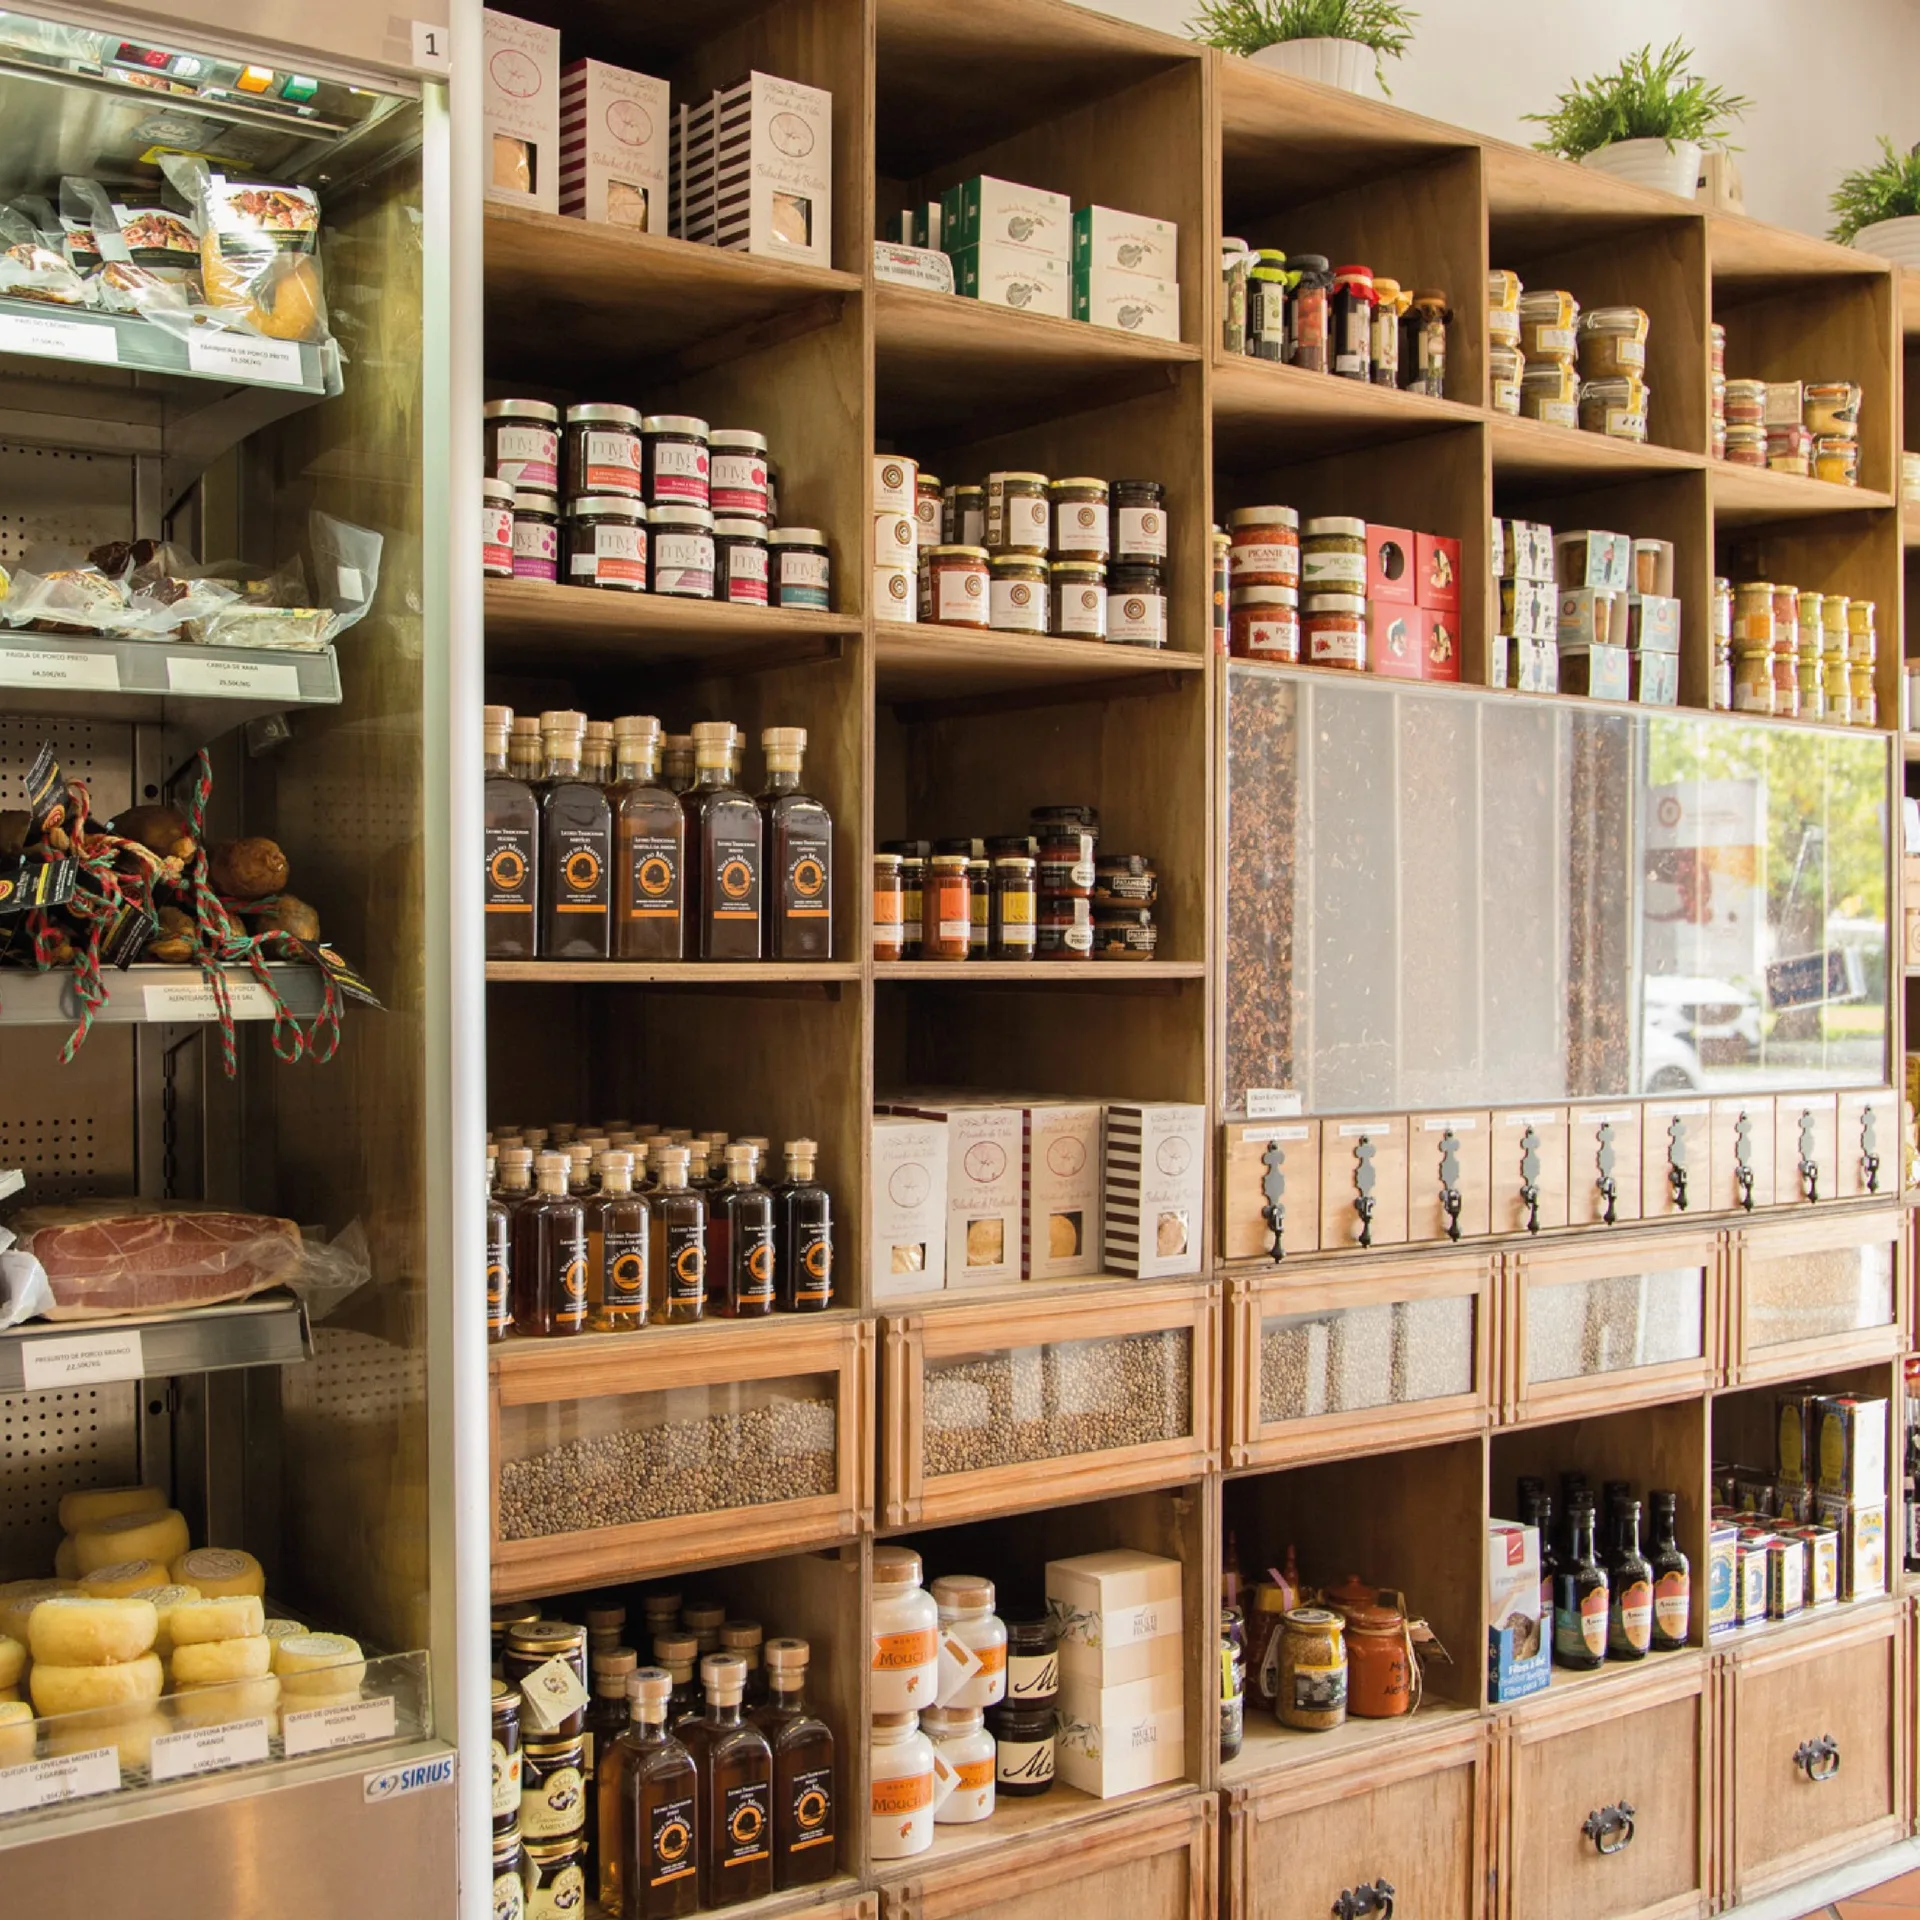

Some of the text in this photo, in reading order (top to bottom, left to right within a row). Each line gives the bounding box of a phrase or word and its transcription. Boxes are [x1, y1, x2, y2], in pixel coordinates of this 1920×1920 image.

[425, 33, 439, 56] 1
[70, 1352, 80, 1360] DE
[80, 1350, 103, 1358] PORCO
[196, 1736, 224, 1748] GRANDE
[29, 1764, 38, 1773] DE
[40, 1757, 70, 1770] OVELHA
[400, 1760, 452, 1790] SIRIUS
